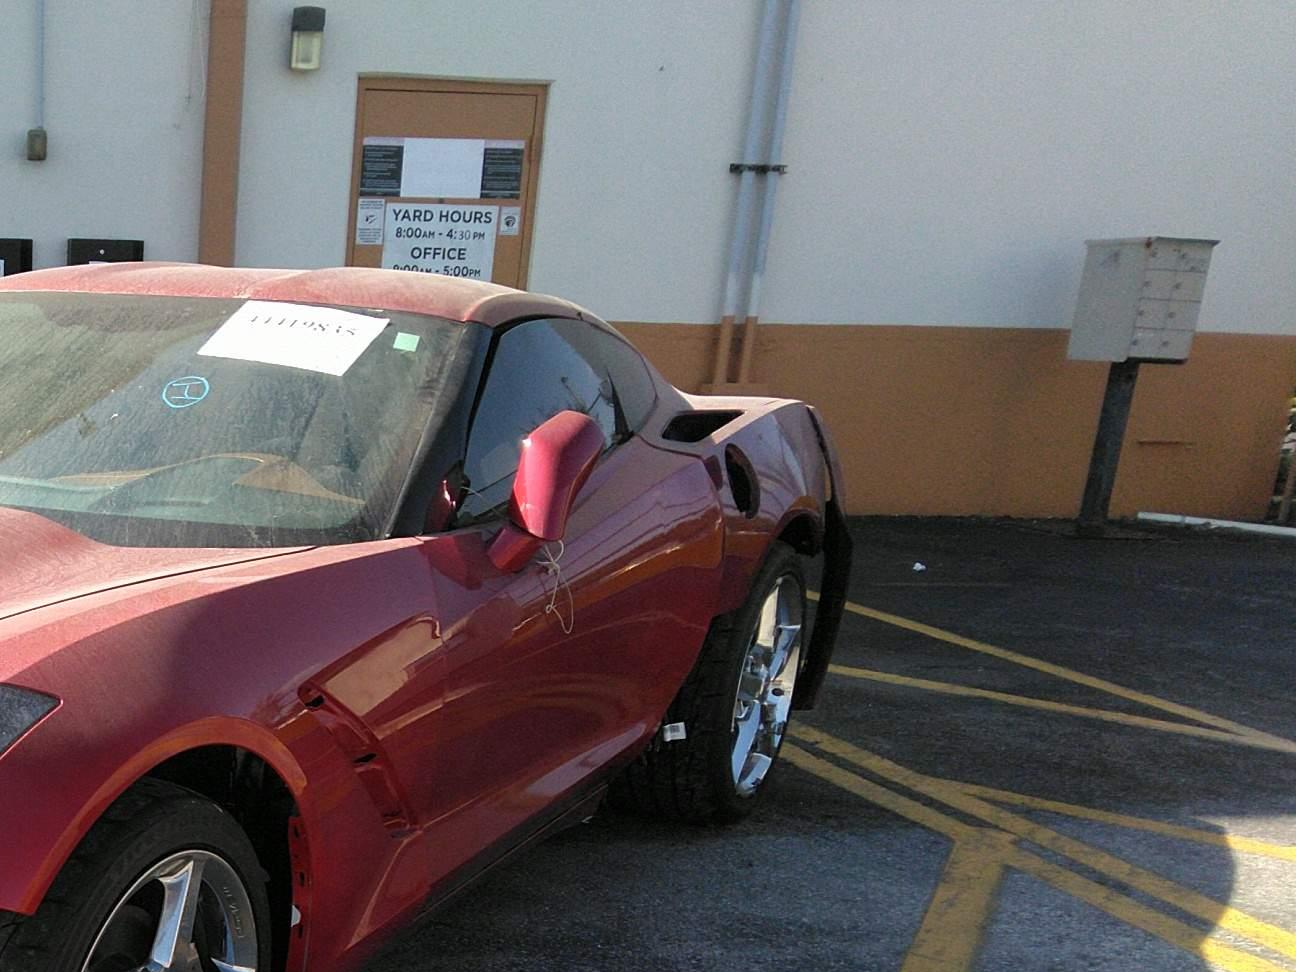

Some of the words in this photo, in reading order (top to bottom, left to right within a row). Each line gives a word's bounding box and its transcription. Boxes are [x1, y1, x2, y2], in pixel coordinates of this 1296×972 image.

[392, 208, 434, 222] YARD
[440, 209, 493, 224] HOURS
[395, 227, 435, 240] 8:00AM
[410, 246, 467, 260] OFFICE
[443, 265, 481, 277] 5:00PM
